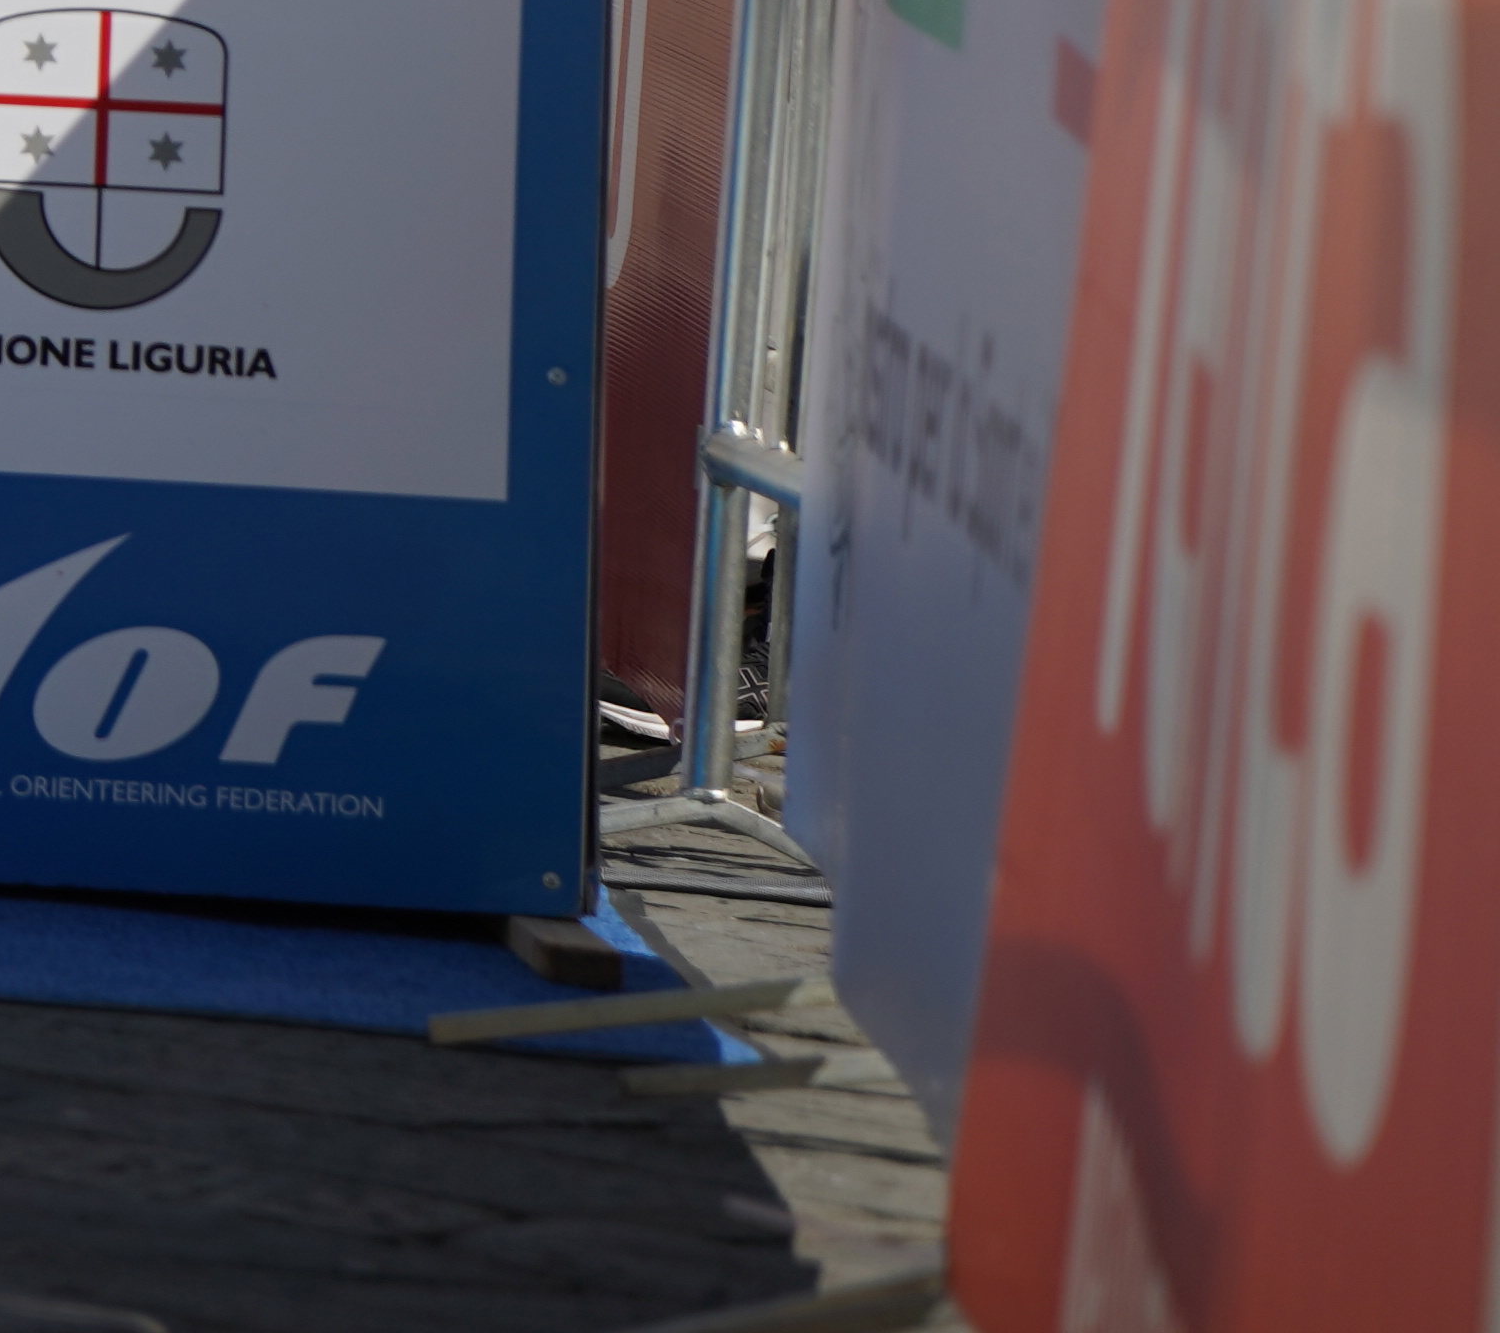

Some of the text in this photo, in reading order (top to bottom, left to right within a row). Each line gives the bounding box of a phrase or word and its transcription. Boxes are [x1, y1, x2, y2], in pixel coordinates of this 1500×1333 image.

[108, 336, 279, 380] LIGURIA
[10, 773, 208, 809] ORIENTEERING
[215, 785, 385, 820] FEDERATION
